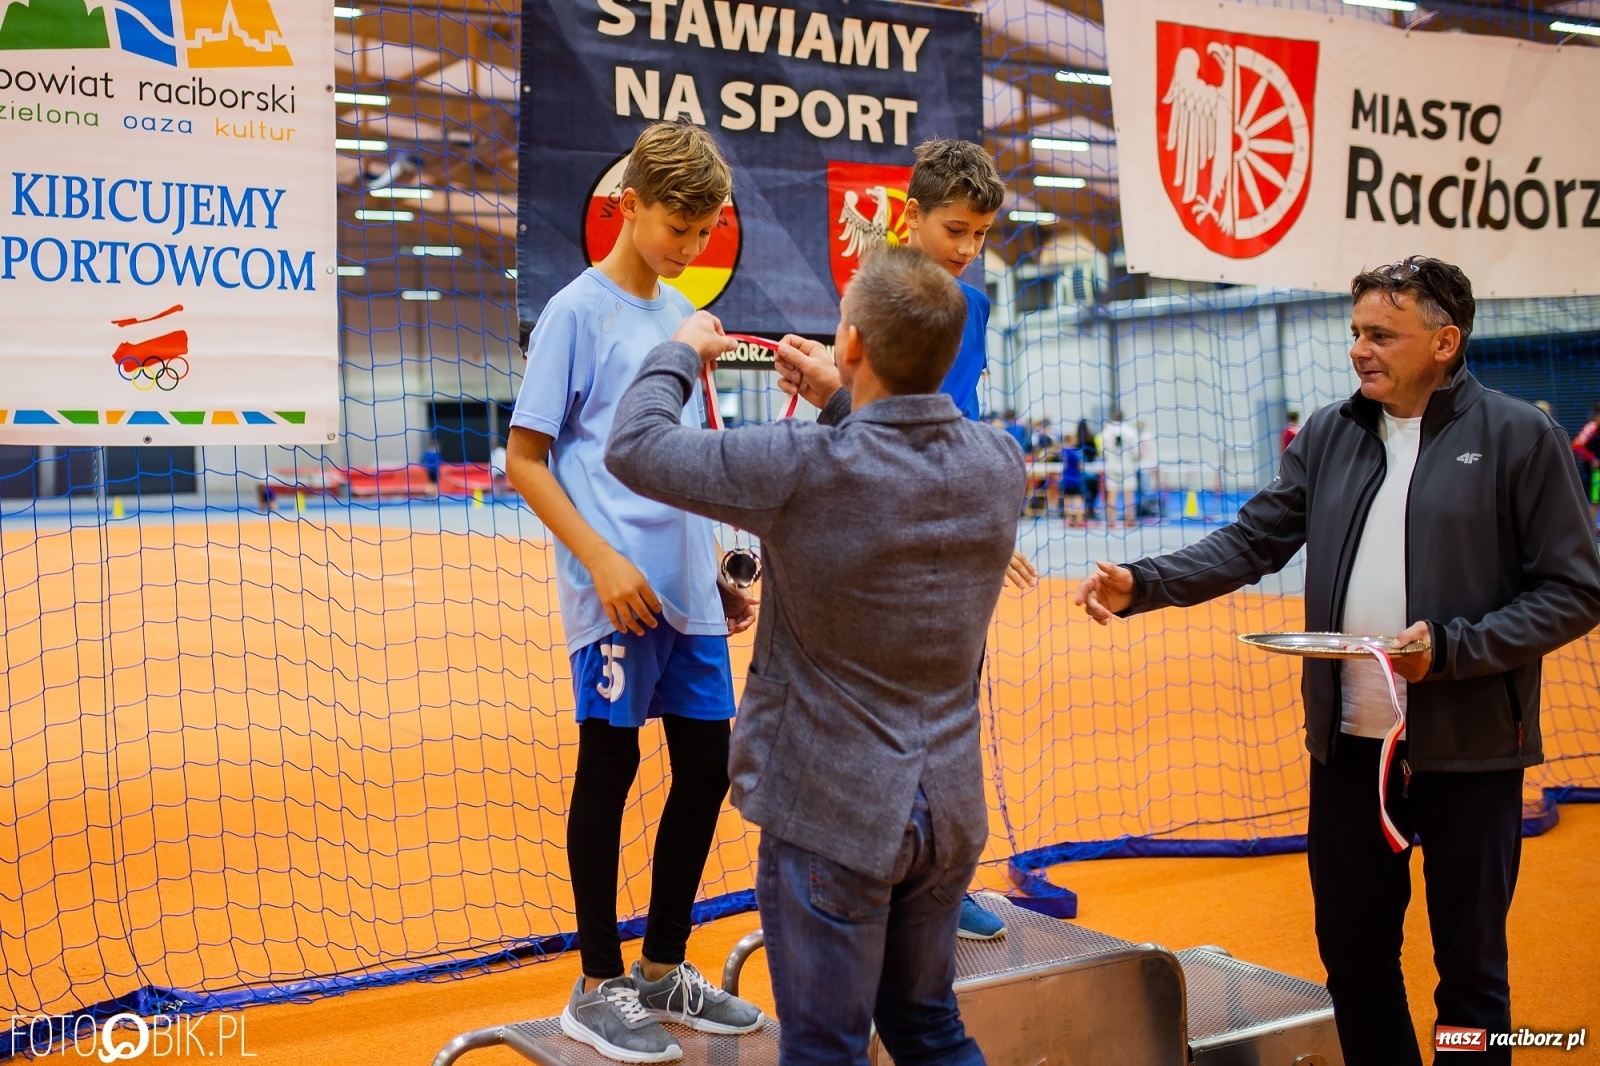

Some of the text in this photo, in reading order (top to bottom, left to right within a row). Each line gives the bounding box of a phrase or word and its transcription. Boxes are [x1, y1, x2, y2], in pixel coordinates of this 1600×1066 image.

[597, 0, 930, 73] STAWIAMY
[139, 76, 296, 114] raciborski
[615, 66, 918, 147] NA SPORT
[1351, 89, 1502, 145] MIASTO
[123, 115, 193, 134] oaza
[215, 117, 296, 142] kultur
[11, 172, 286, 235] KIBICUJEMY
[1345, 145, 1600, 231] Racibórz
[1, 236, 316, 291] PORTOWCOM
[1456, 452, 1483, 464] 4F
